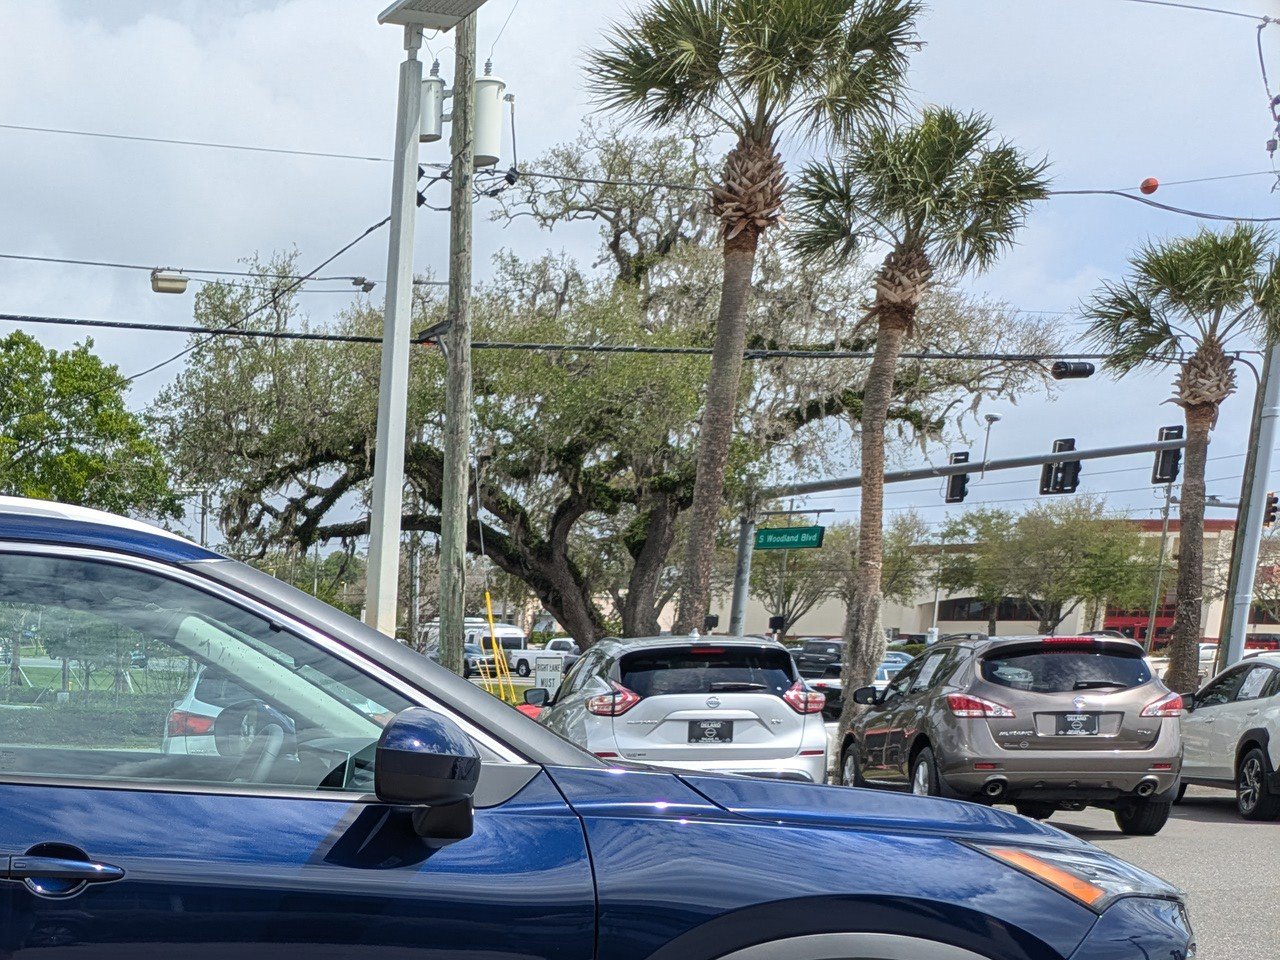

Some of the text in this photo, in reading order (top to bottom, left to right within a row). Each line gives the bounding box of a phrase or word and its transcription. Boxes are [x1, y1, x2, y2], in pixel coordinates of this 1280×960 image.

[759, 533, 817, 543] S Woodland Blvd
[541, 678, 555, 687] MUST
